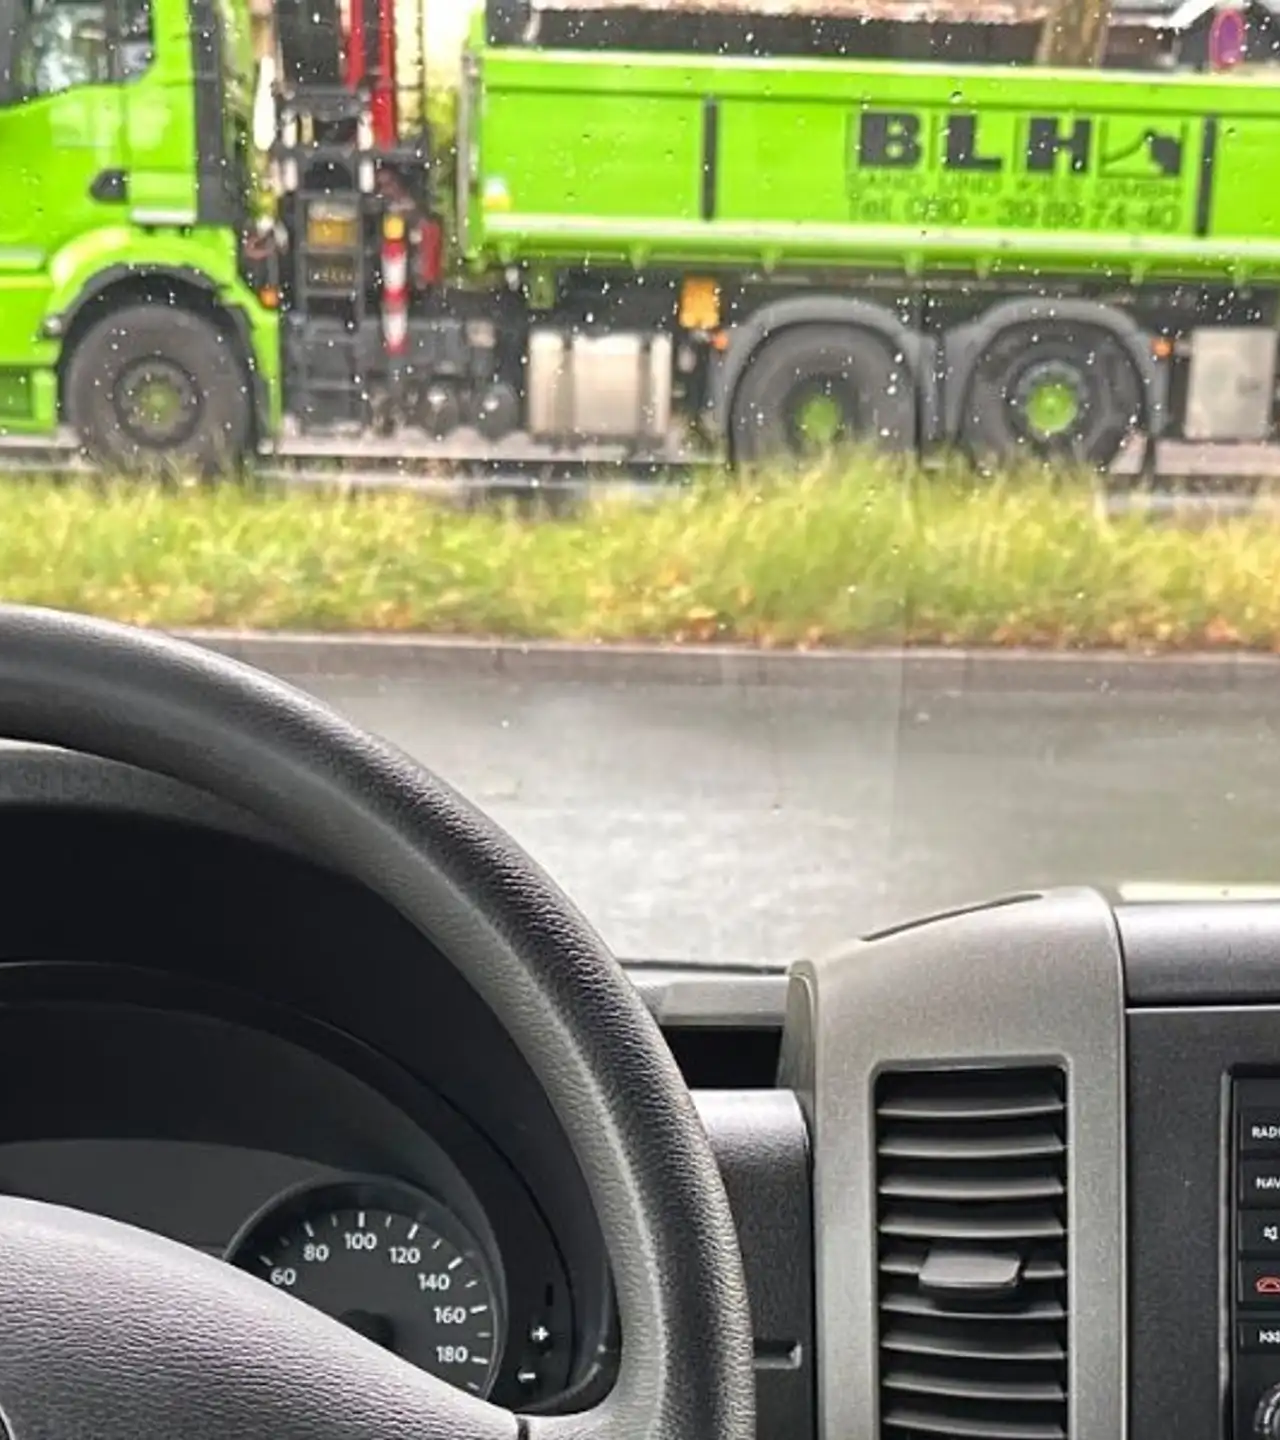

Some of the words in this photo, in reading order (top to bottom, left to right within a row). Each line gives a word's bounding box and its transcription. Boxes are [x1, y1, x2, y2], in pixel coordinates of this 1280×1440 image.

[858, 112, 1092, 174] BLH
[344, 1233, 377, 1250] 100
[303, 1245, 329, 1262] 80
[389, 1247, 420, 1265] 120
[270, 1268, 296, 1286] 60
[419, 1273, 451, 1290] 140
[434, 1307, 466, 1325] 160
[436, 1347, 469, 1363] 180
